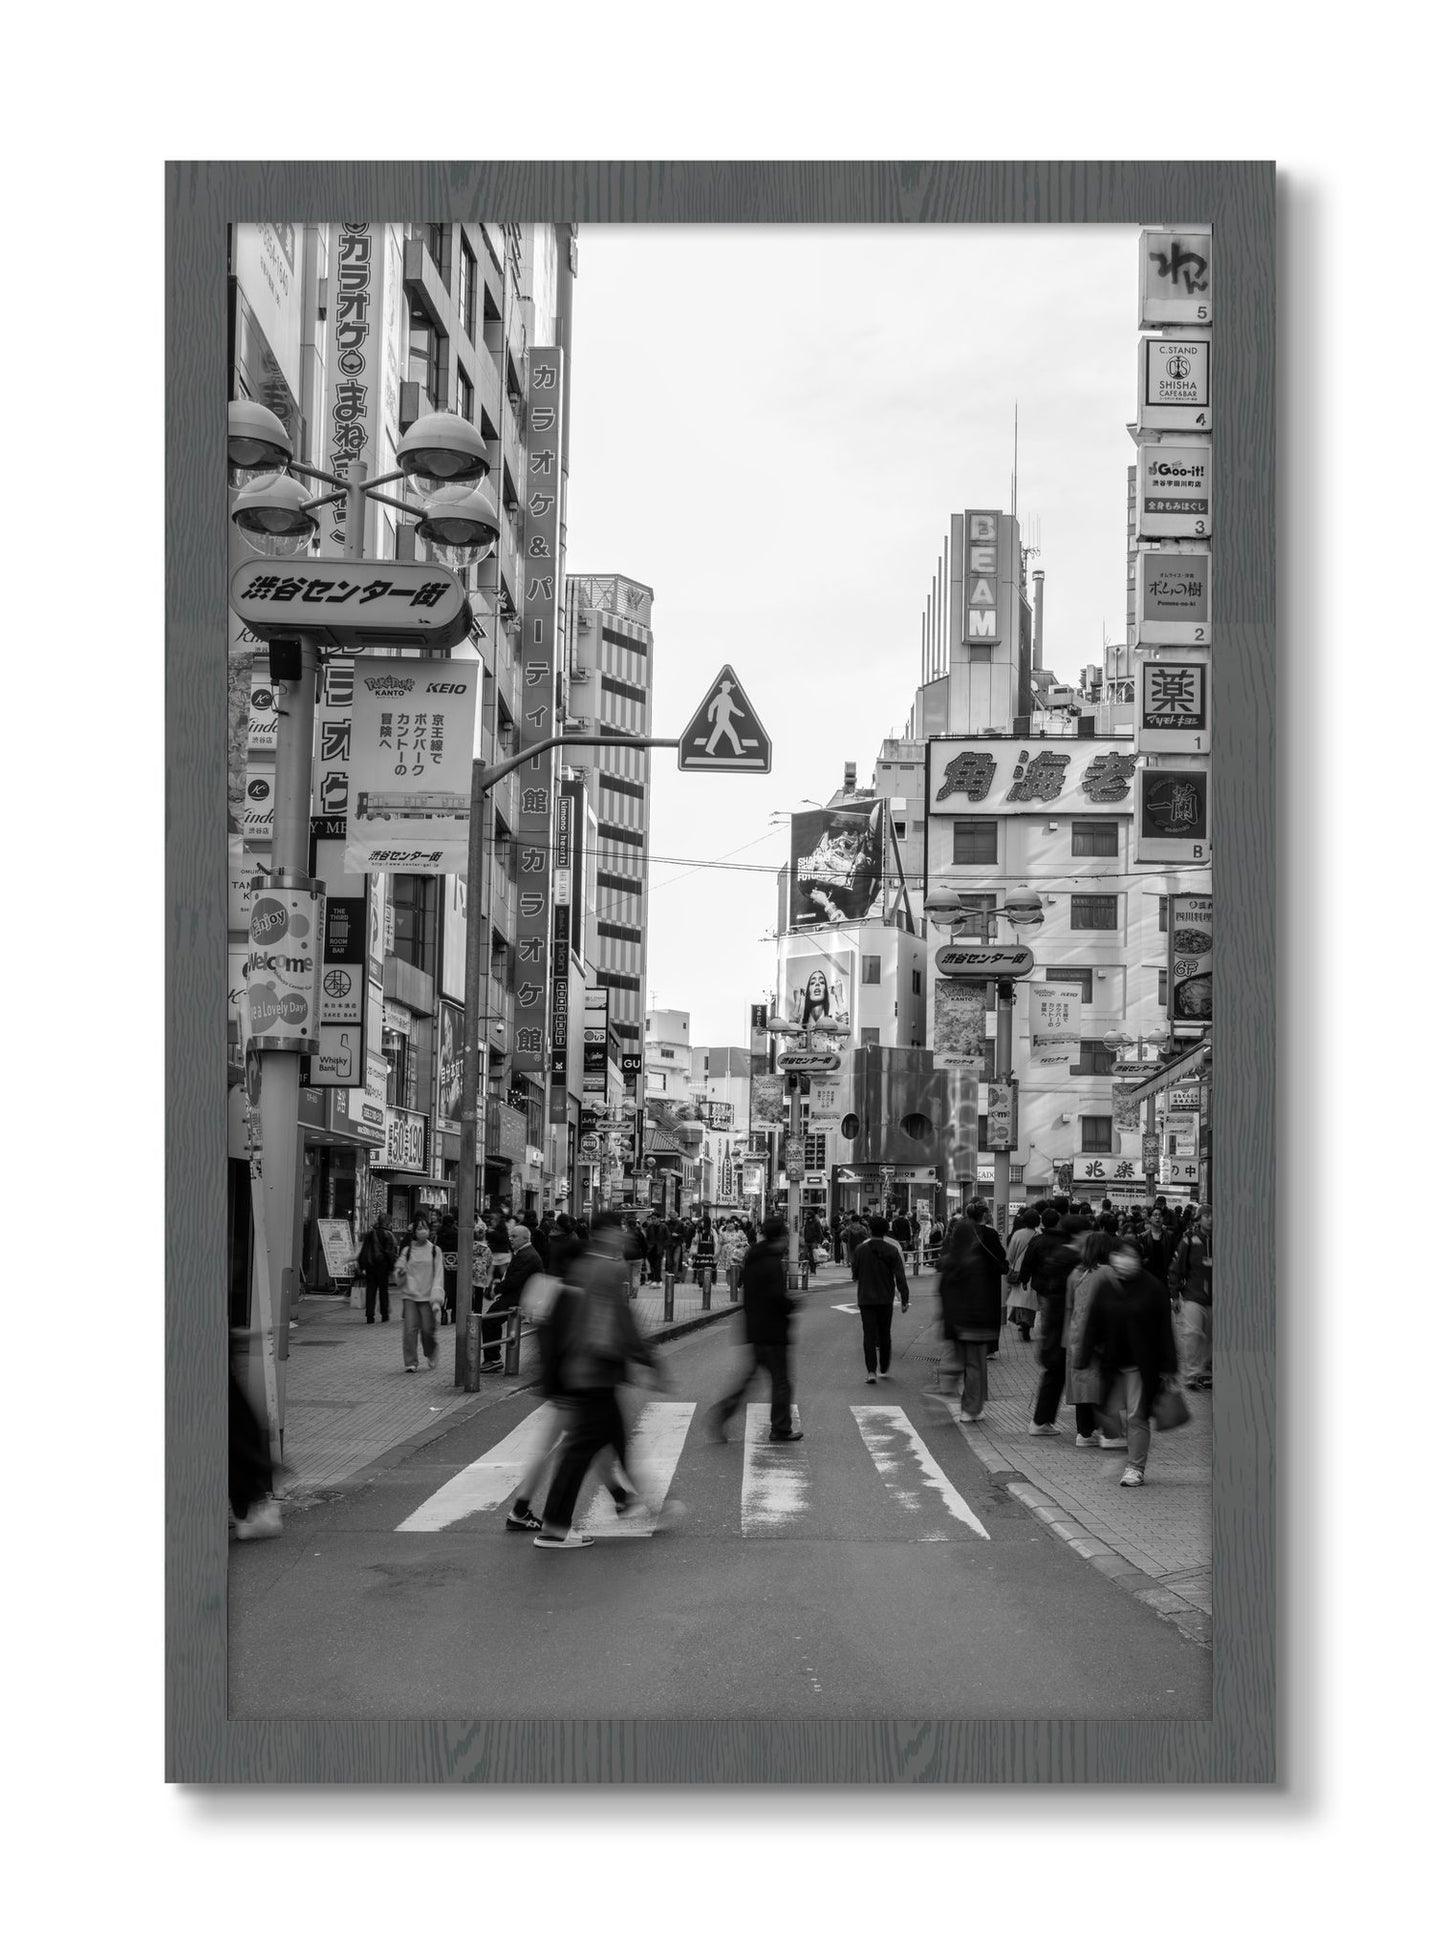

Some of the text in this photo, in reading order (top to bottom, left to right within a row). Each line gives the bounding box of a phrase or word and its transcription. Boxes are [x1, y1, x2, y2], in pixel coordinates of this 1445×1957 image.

[336, 235, 372, 350] カラオケ
[1196, 306, 1208, 320] 5
[1159, 380, 1198, 390] SHISHA
[1158, 463, 1205, 477] Goo-it!
[1148, 501, 1206, 511] 全身もみほぐし
[1194, 520, 1205, 535] 3
[968, 514, 996, 637] BEAM
[240, 575, 451, 608] 渋谷センター街
[1194, 627, 1205, 641] 2
[374, 689, 405, 697] KANTO
[425, 683, 468, 695] KEIO
[1151, 669, 1196, 712] 薬
[378, 713, 393, 750] 冒険へ
[394, 713, 410, 776] カントーの
[430, 714, 445, 764] 京王線で
[1193, 736, 1202, 750] 1
[559, 800, 568, 864] kimono hearts
[368, 850, 444, 862] 渋谷センター街
[1193, 845, 1203, 858] B
[251, 909, 286, 939] Enjoy
[515, 848, 547, 1054] カラオケ館
[941, 953, 1029, 965] 渋谷センター街
[1174, 960, 1199, 979] 6F
[262, 1001, 289, 1018] Lovely
[289, 1001, 307, 1014] Day!
[319, 1056, 348, 1067] Whisky
[319, 1064, 337, 1072] Bank
[623, 1059, 641, 1069] GU
[1085, 1160, 1136, 1179] 兆楽
